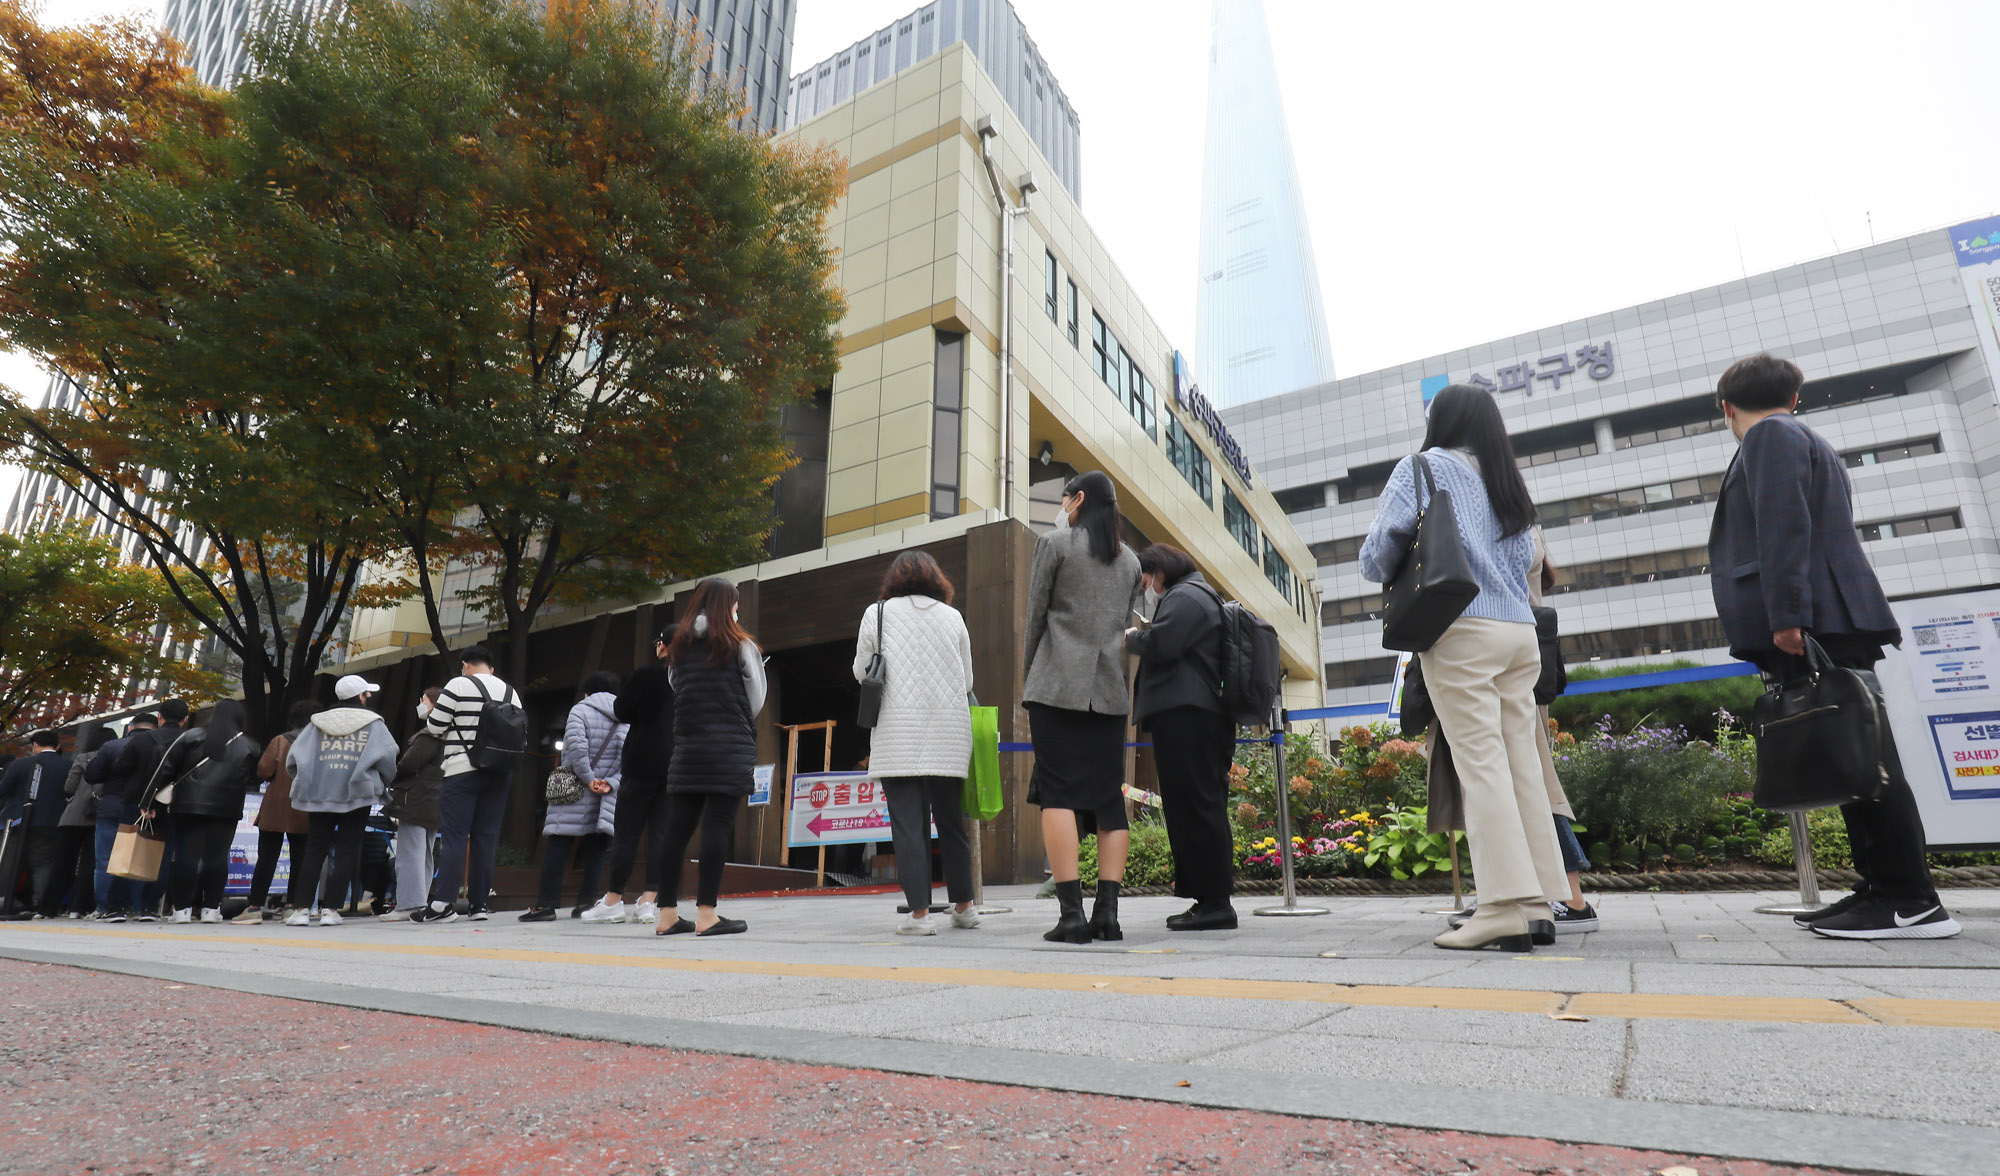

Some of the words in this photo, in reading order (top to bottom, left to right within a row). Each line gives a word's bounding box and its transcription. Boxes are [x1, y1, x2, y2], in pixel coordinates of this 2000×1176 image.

[1958, 239, 1970, 252] I
[320, 740, 366, 753] PART
[1955, 766, 1985, 777] 자전거
[811, 790, 827, 802] STOP
[831, 819, 864, 830] 코로나19
